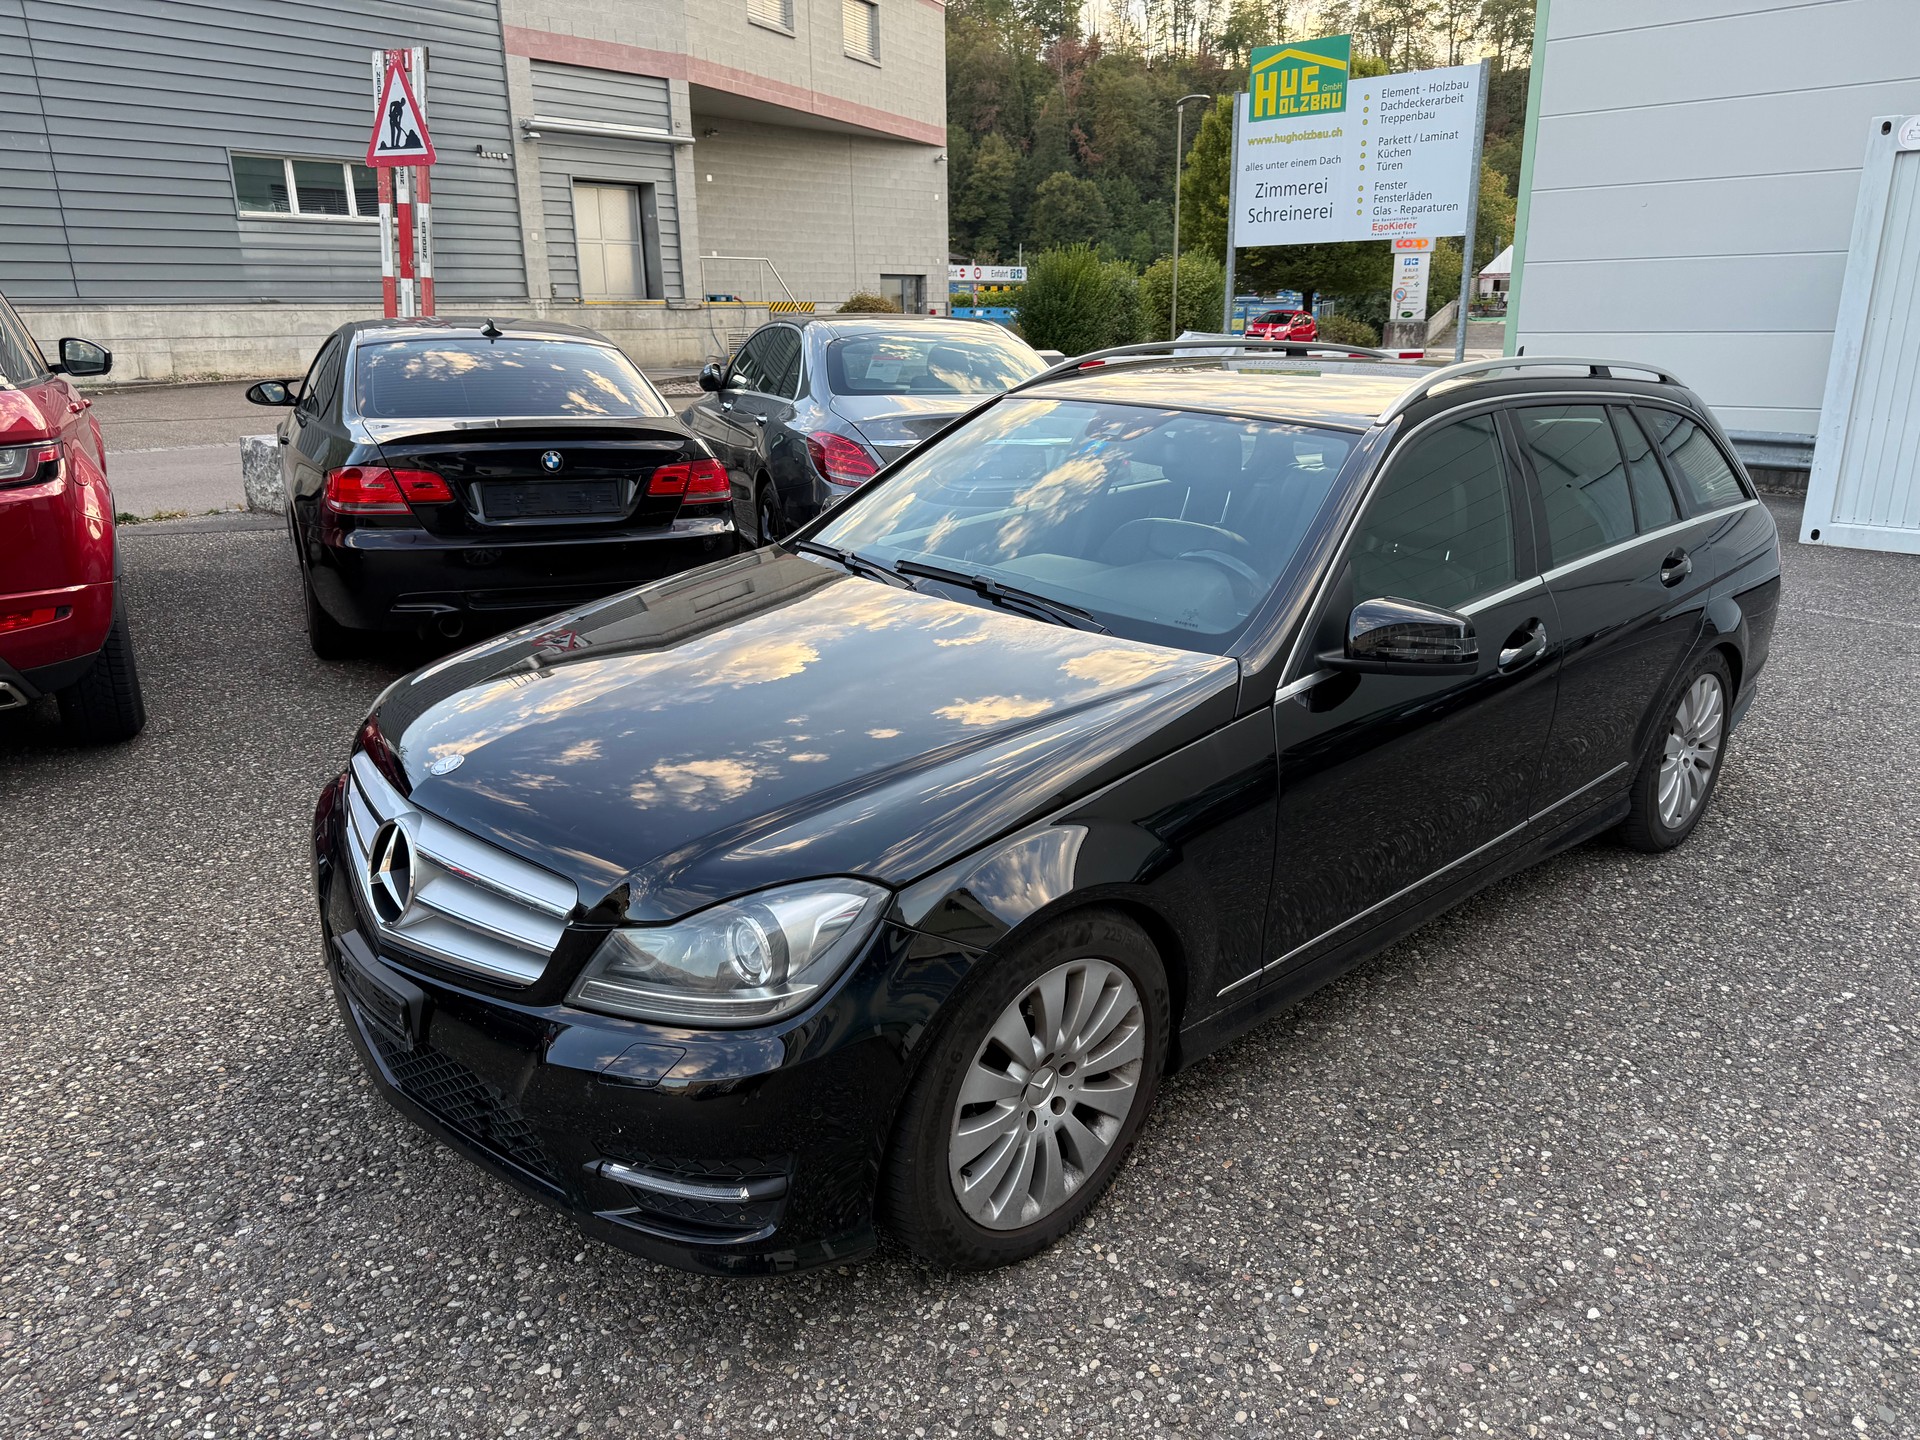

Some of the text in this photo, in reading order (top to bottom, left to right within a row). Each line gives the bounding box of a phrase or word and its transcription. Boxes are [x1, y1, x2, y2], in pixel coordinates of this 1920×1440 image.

[1254, 65, 1343, 117] HUG GmbH
[1381, 86, 1420, 98] Element
[1428, 80, 1469, 93] Holzbau
[1380, 93, 1464, 111] Dachdeckerarbeit
[1379, 111, 1436, 125] Treppenbau
[1247, 127, 1343, 146] www.hugholzbau.ch
[1378, 135, 1412, 146] Parkett
[1420, 130, 1459, 142] Laminat
[1377, 148, 1412, 159] Küchen
[1245, 155, 1342, 172] alles unter einem Dach
[1376, 161, 1403, 171] Türen
[1255, 177, 1328, 199] Zimmerei
[1374, 181, 1407, 191] Fenster
[1373, 191, 1433, 203] Fensterläden
[1248, 202, 1333, 224] Schreinerei
[1372, 206, 1392, 215] Glas
[1400, 203, 1459, 215] Reparaturen
[1372, 221, 1417, 232] EgoKiefer
[1395, 239, 1429, 250] coop
